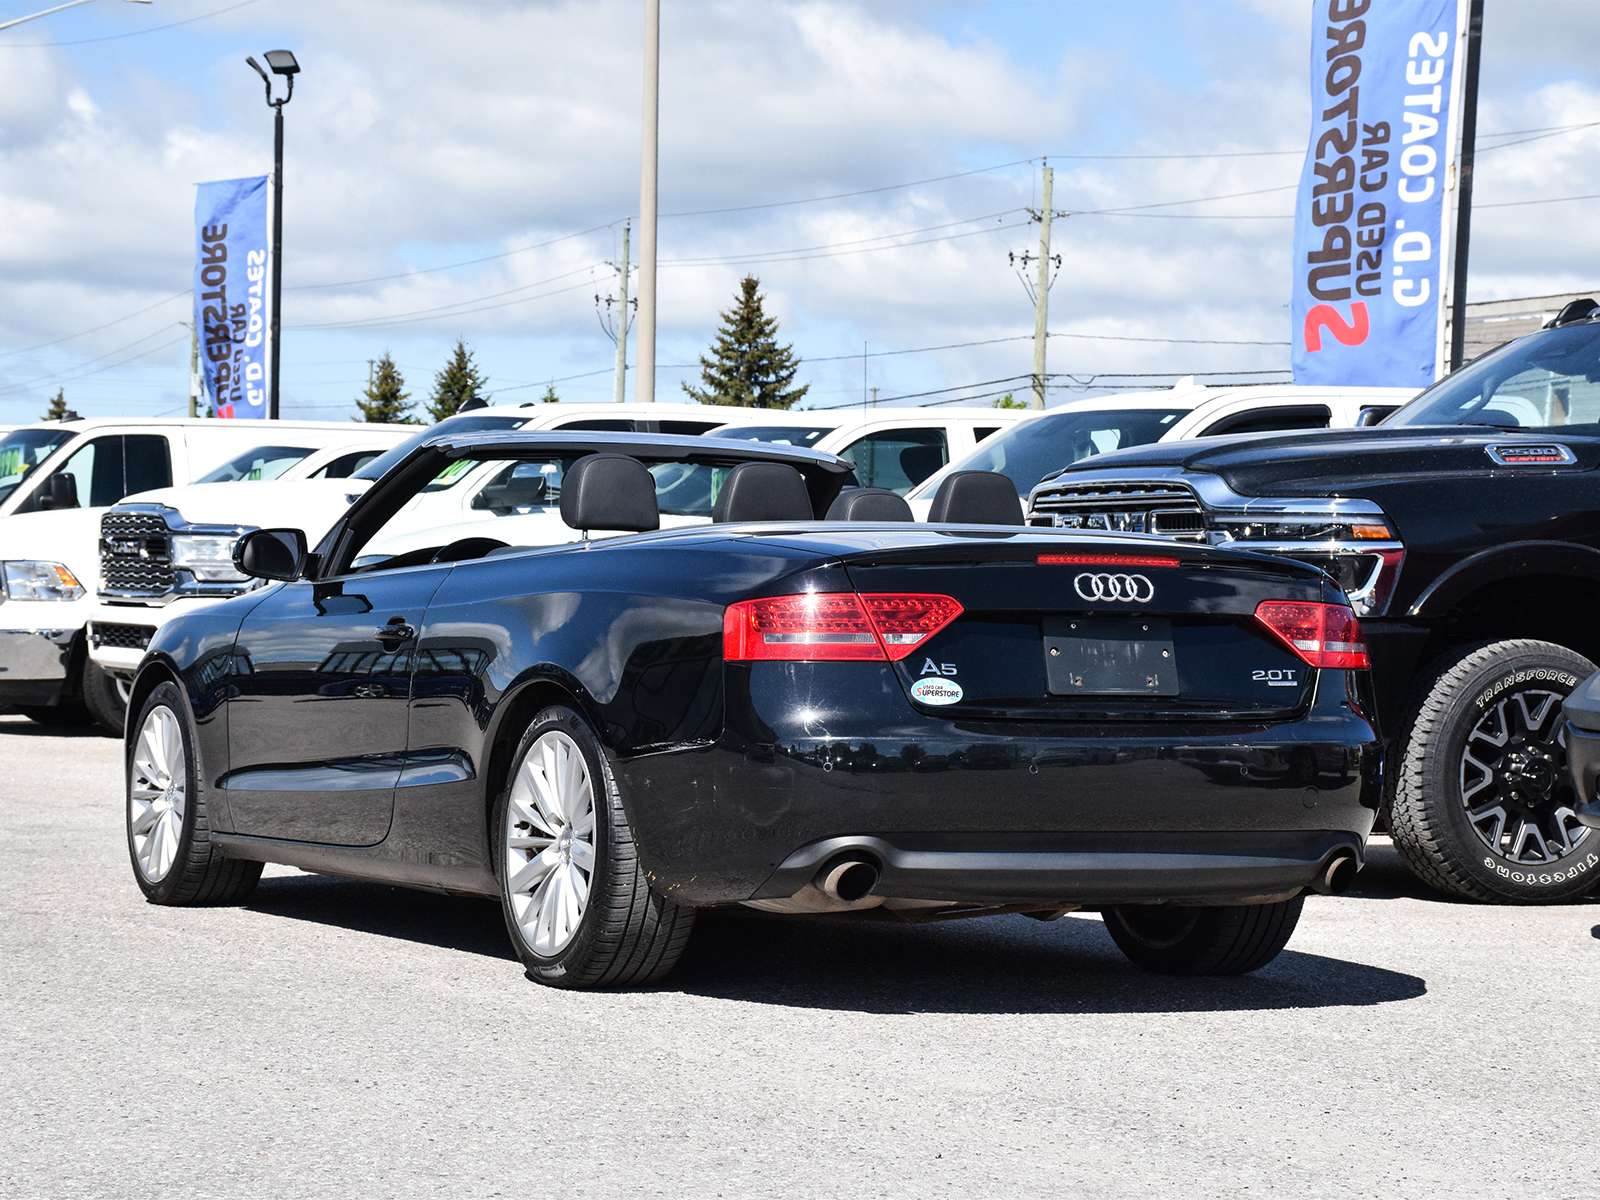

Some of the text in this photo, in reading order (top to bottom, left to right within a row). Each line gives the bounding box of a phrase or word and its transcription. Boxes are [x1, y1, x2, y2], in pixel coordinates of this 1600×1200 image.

[920, 657, 958, 676] A5
[1252, 669, 1296, 680] 2.0T
[916, 687, 960, 698] SUPERSTORE
[1476, 669, 1577, 708] TRANSFORCE
